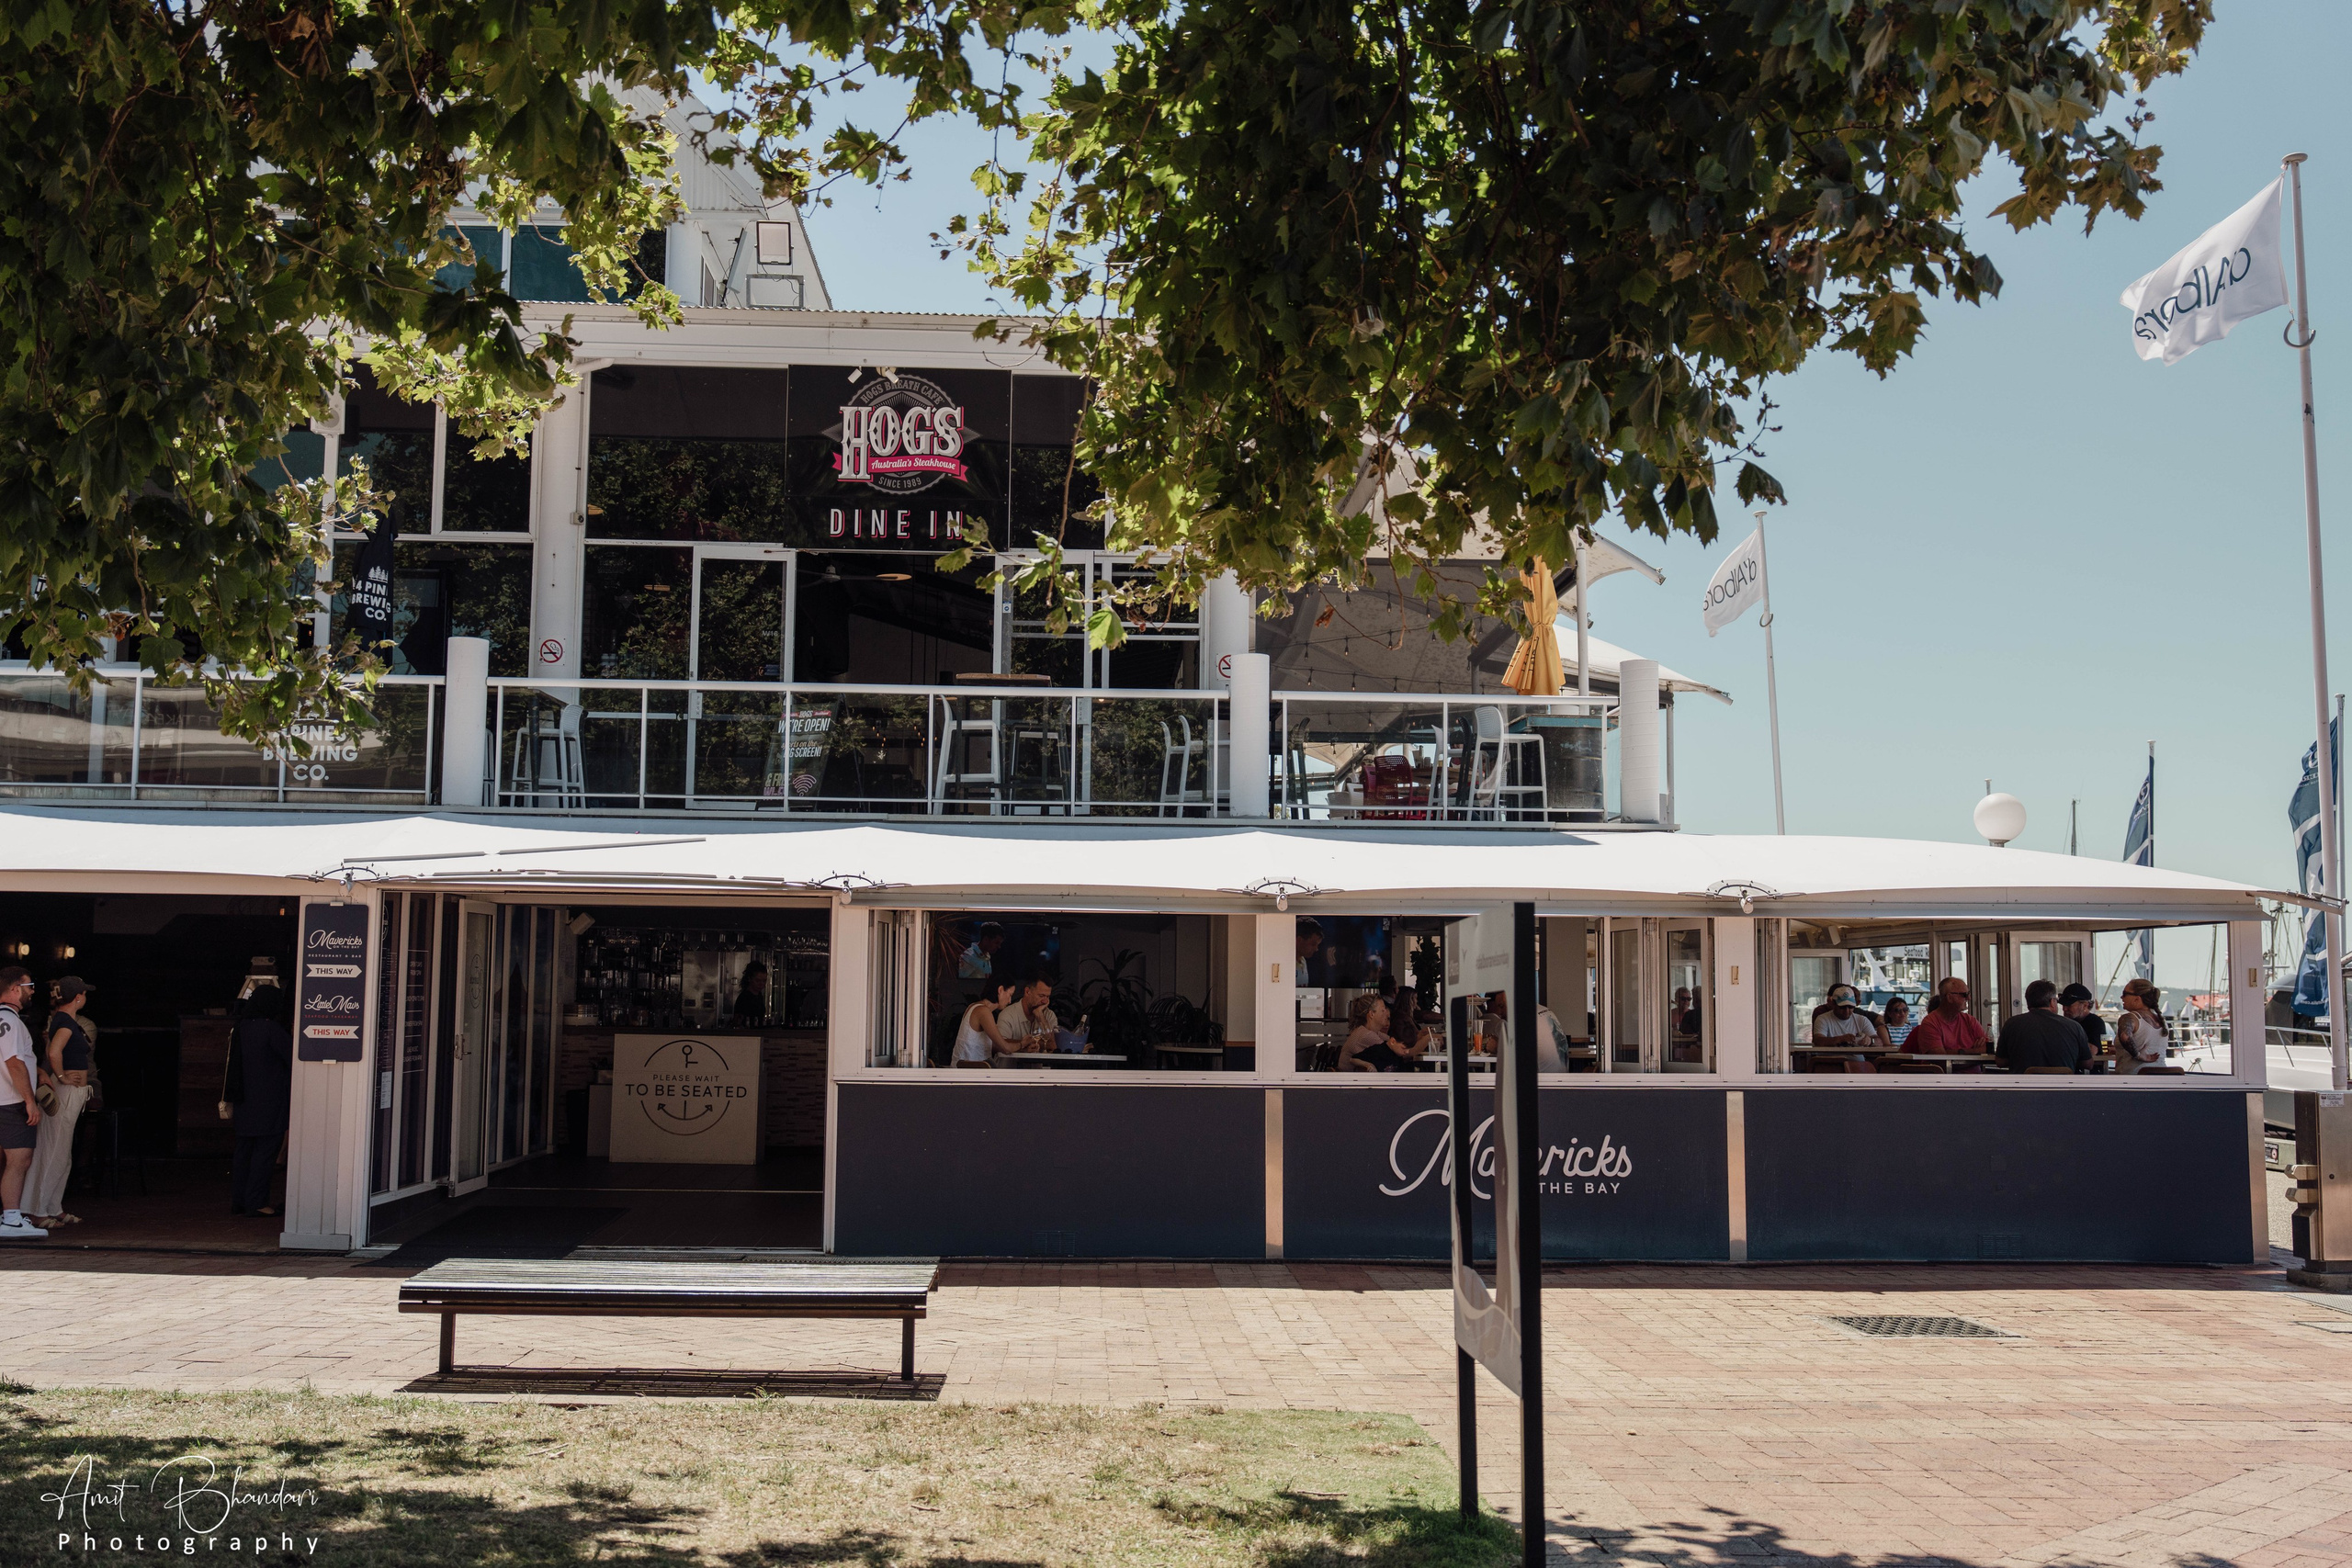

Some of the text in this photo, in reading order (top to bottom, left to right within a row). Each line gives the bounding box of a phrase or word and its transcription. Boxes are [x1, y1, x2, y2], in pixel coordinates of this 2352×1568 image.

[860, 384, 884, 404] HOGS
[884, 379, 921, 391] BREATH
[872, 457, 956, 470] Australia's Steakhouse
[878, 476, 922, 489] SINCE 1989
[830, 508, 963, 540] DINE IN
[365, 606, 387, 621] CO.
[778, 717, 831, 733] W'RE OPEN!
[795, 746, 822, 758] SCREEN!
[293, 763, 330, 781] CO.
[307, 930, 363, 950] Mavericks
[304, 994, 360, 1014] Little Mavs
[652, 1074, 720, 1083] PLEASE WAIT
[625, 1083, 748, 1099] TO BE SEATED
[1378, 1109, 1633, 1200] Maricks
[1538, 1182, 1621, 1194] THE BAY
